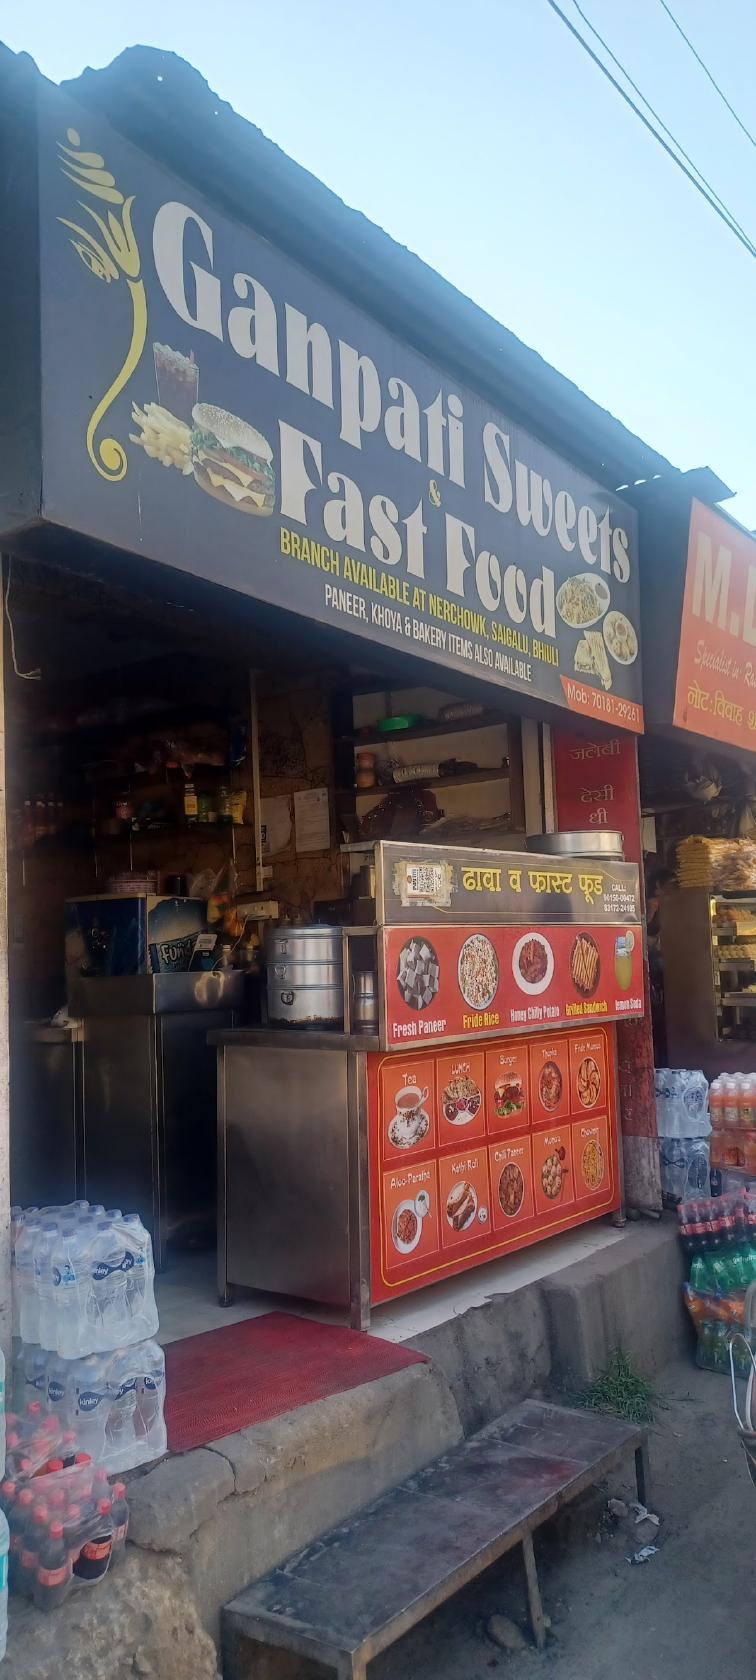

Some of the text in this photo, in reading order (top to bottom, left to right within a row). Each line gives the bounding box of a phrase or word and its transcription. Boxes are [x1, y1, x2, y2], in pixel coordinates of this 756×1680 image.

[152, 201, 632, 584] Ganpati Sweets
[428, 479, 442, 508] &
[278, 418, 557, 639] Fast Food
[279, 525, 340, 577] BRANCH
[343, 555, 411, 606] AVAILABLE
[412, 586, 427, 612] AT
[429, 593, 490, 641] NERCHOWK,
[491, 620, 531, 659] SAIGALU,
[324, 583, 533, 683] PANEER, KHOYA & BAKERY ITEMS ALSO AVAILABLE
[566, 682, 641, 723] Mob: 70181-29261
[713, 689, 744, 727] विवाह
[528, 871, 572, 894] फास्ट
[611, 884, 627, 892] CALL:
[510, 1008, 527, 1023] Honey
[543, 1004, 560, 1018] Potato
[583, 1000, 608, 1014] Sandwich
[630, 998, 642, 1009] Soda
[393, 1018, 447, 1038] Fresh Paneer
[484, 1011, 500, 1026] Rice
[500, 1054, 518, 1066] Burger
[402, 1072, 417, 1086] Tea
